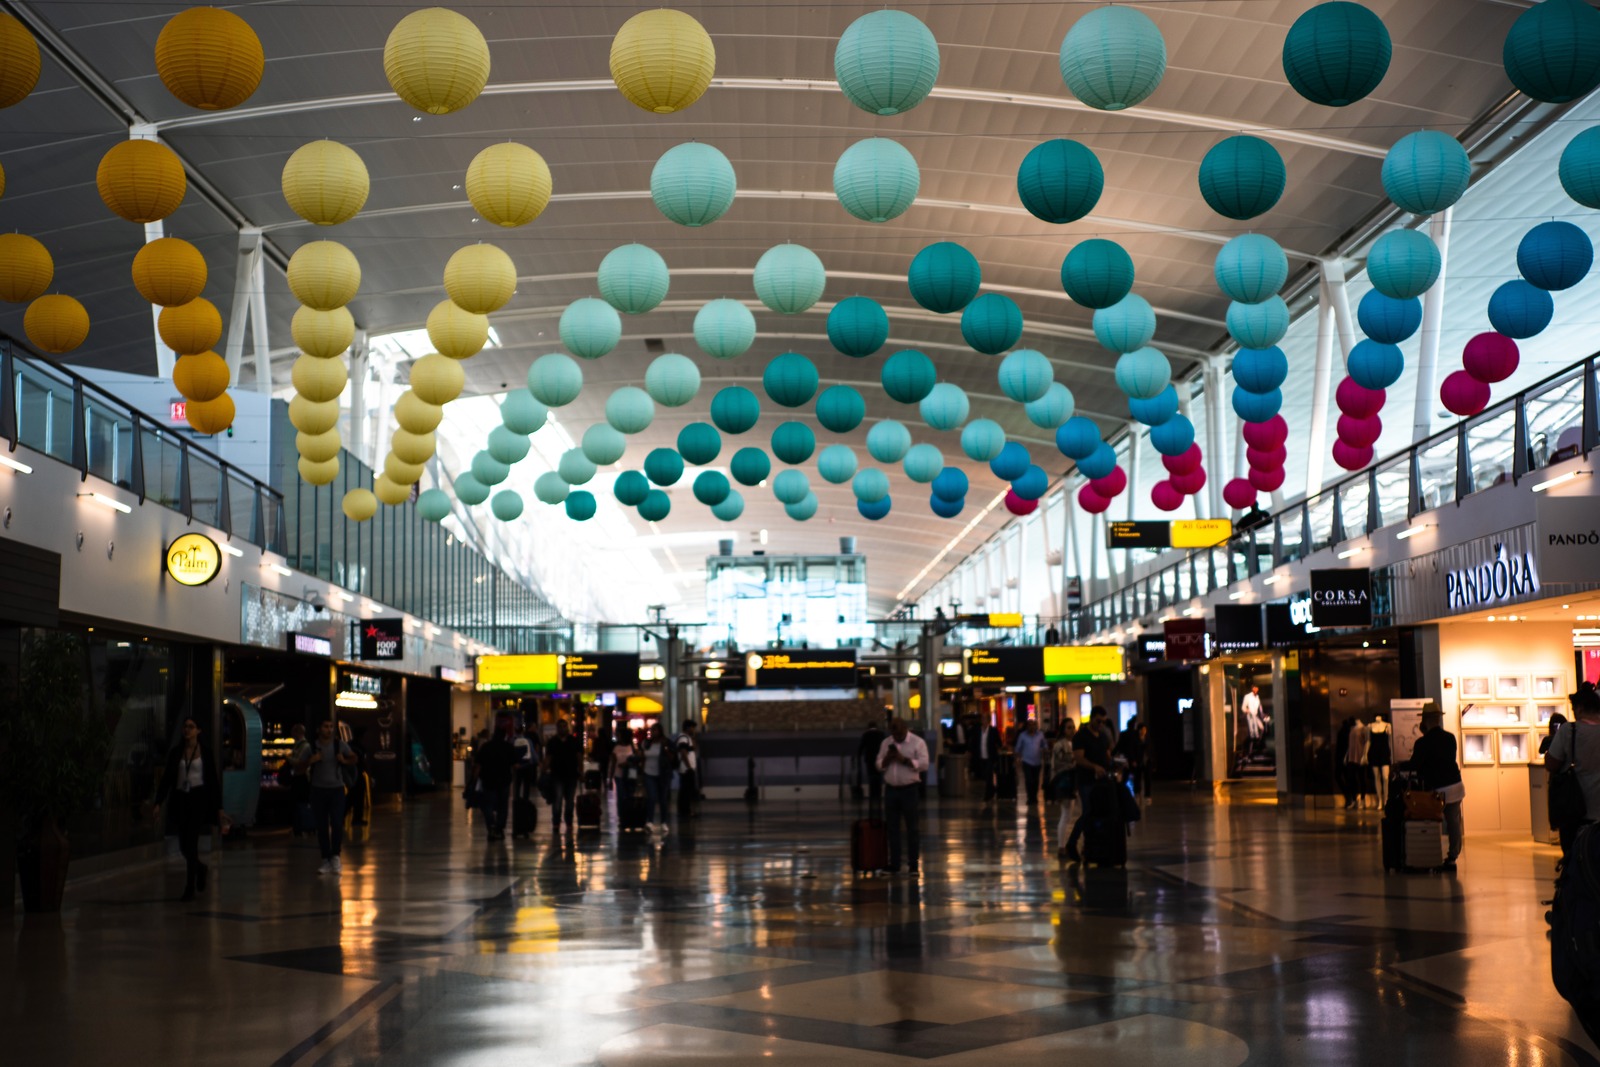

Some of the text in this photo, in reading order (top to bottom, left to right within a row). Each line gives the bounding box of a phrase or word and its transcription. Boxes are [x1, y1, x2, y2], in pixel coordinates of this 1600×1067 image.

[171, 545, 208, 568] Palm
[1445, 545, 1536, 608] PANDORA
[1313, 589, 1368, 601] CORSA
[376, 641, 397, 649] FOOD
[376, 648, 395, 656] HALL
